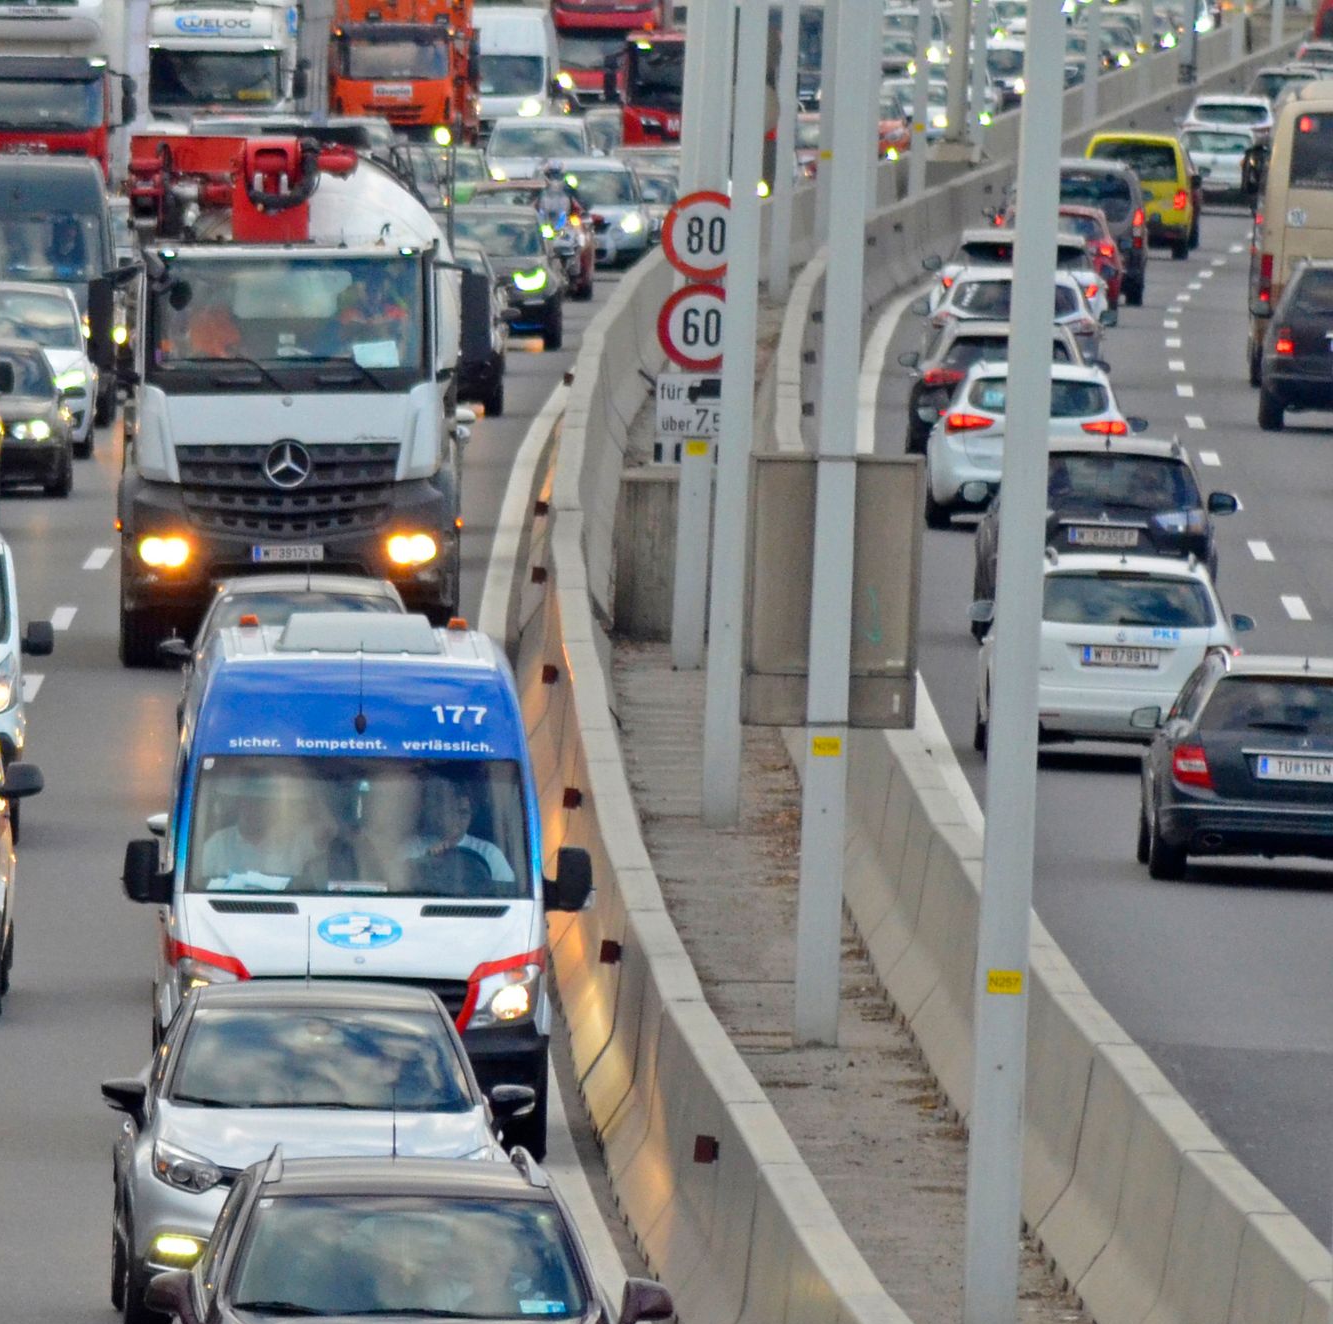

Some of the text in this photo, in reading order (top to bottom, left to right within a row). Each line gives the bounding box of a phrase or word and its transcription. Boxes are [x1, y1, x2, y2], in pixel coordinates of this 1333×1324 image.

[686, 216, 727, 256] 80
[682, 308, 722, 347] 60
[660, 383, 684, 401] für
[661, 415, 692, 432] über
[1152, 629, 1181, 641] PKE
[431, 704, 488, 725] 177
[229, 737, 494, 753] sicher. kompetent. verlässlich.
